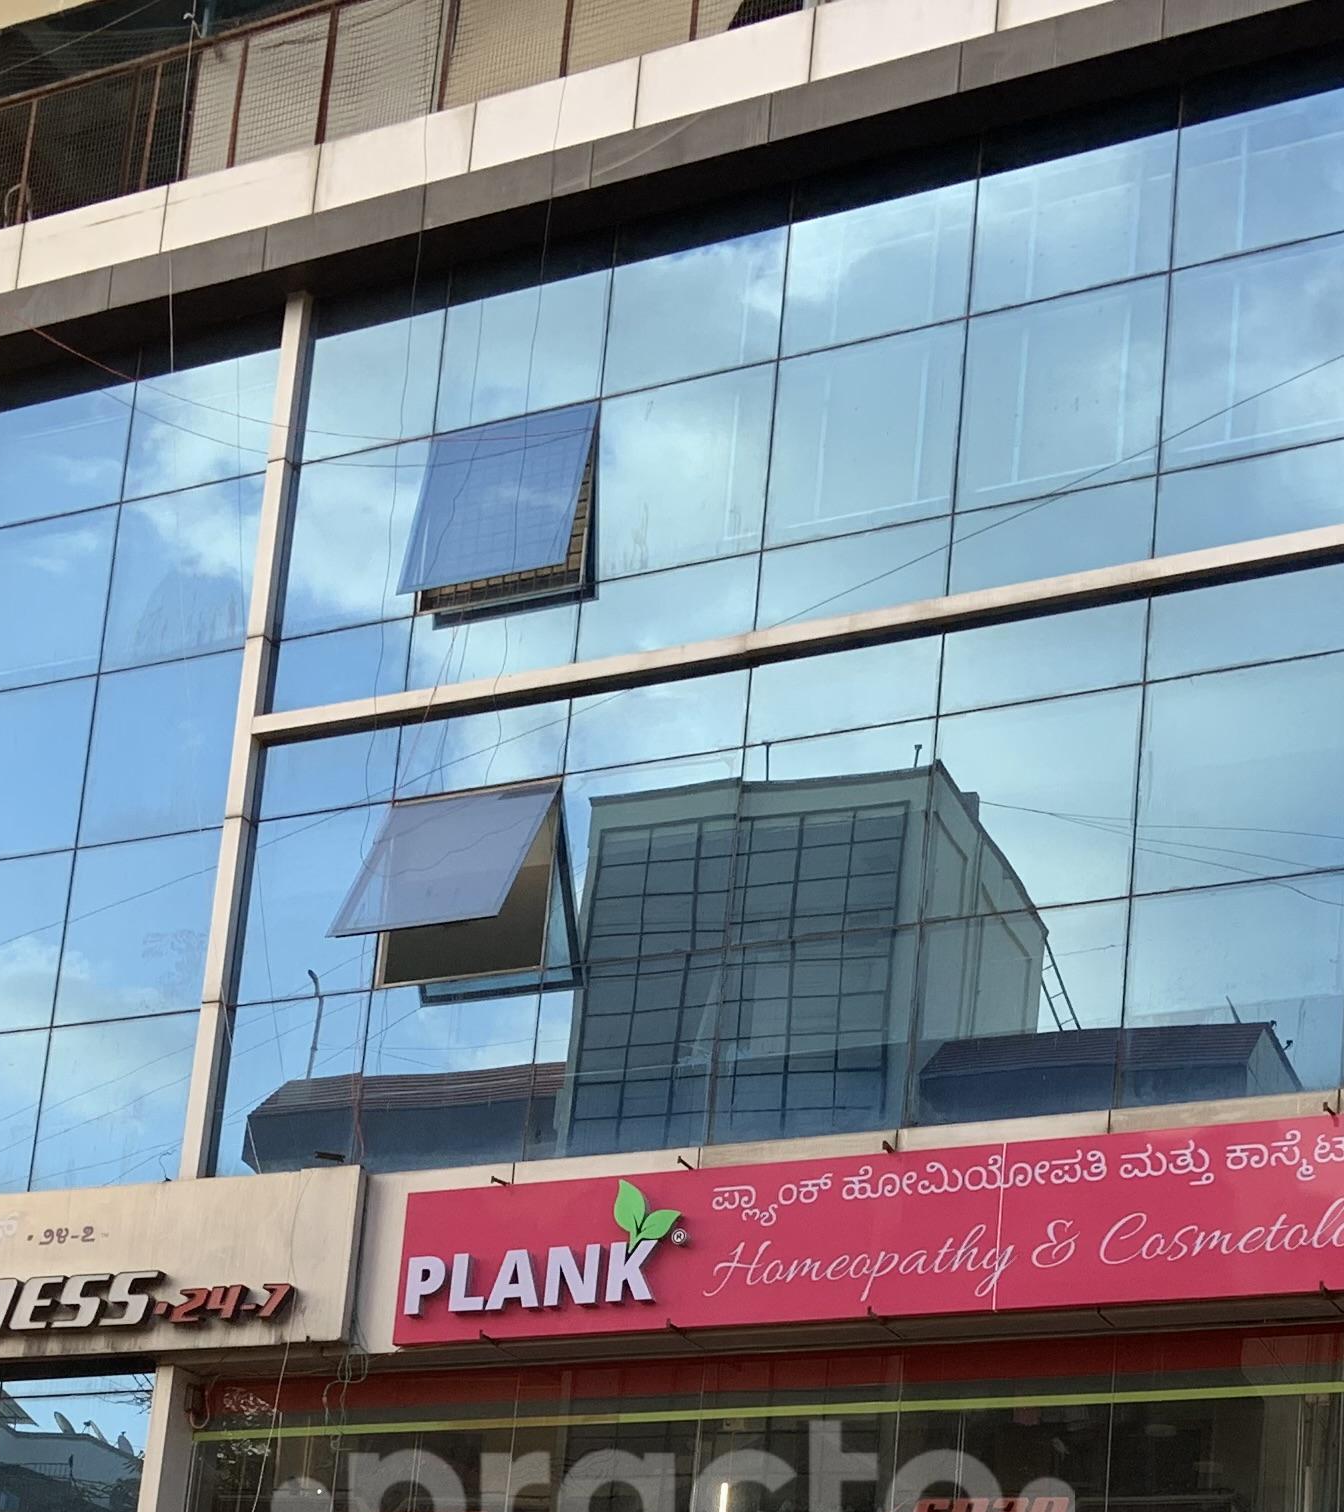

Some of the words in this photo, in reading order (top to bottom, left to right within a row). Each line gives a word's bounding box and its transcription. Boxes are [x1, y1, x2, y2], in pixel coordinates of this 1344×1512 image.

[841, 1149, 1108, 1201] ಹೋಮಿಯೋಪತಿ
[1120, 1139, 1216, 1187] ಮತ್ತು
[403, 1239, 659, 1317] PLANK
[703, 1224, 1016, 1301] Homeopathy
[1031, 1219, 1080, 1270] &
